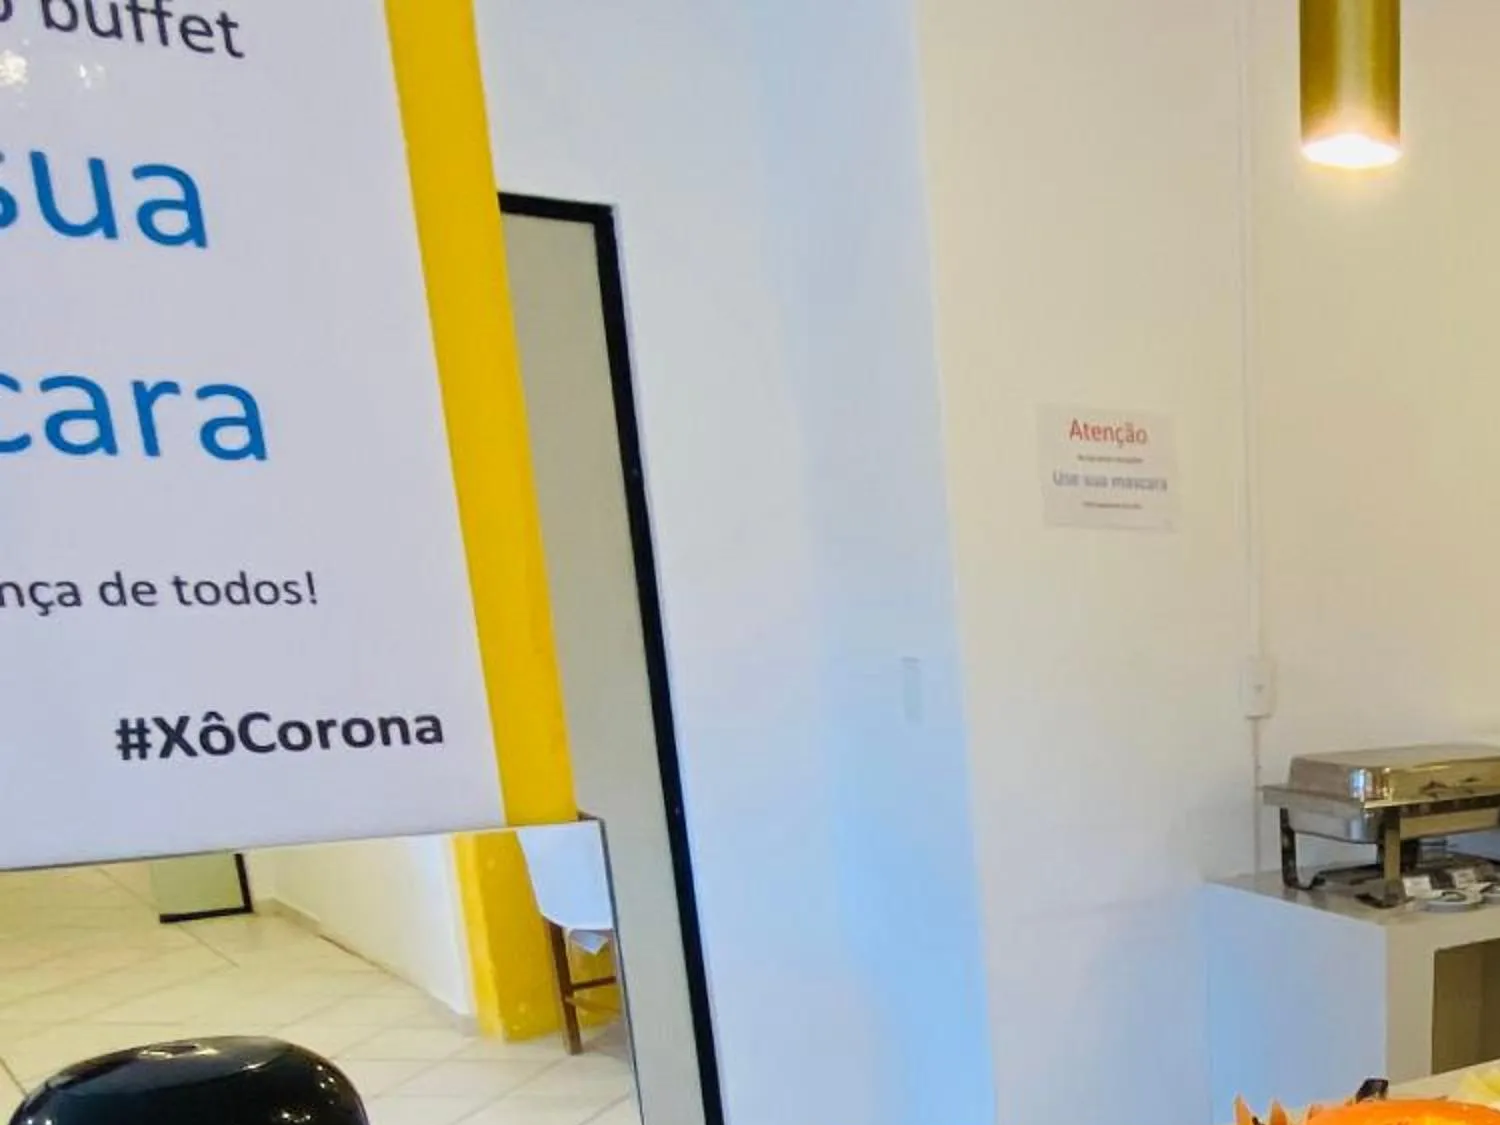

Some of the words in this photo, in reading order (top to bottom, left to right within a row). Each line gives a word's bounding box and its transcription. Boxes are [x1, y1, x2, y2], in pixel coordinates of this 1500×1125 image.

[40, 0, 244, 58] buffet
[1069, 417, 1148, 448] Atenção
[99, 570, 158, 607] de
[171, 570, 318, 606] todos!
[115, 711, 444, 761] #XôCorona
